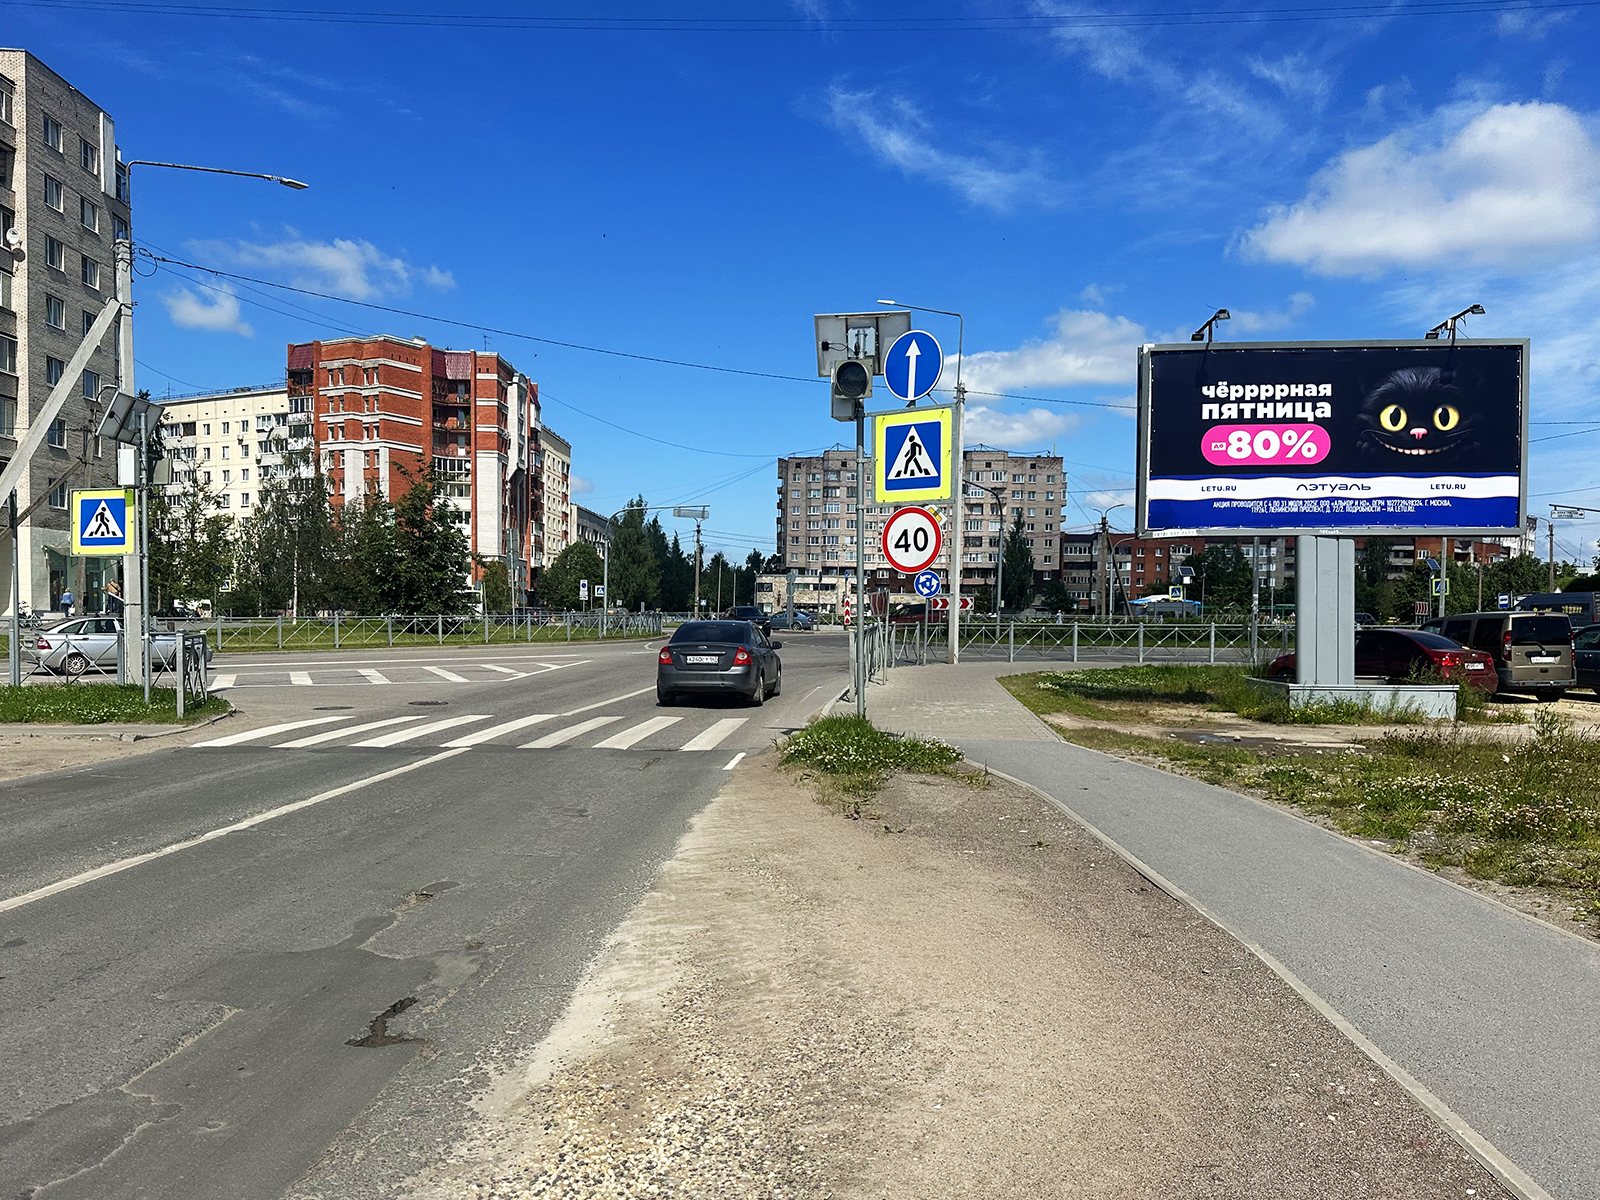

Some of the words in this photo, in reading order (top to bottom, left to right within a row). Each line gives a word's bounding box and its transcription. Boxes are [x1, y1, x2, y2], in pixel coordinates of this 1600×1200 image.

[1201, 381, 1332, 401] чёррррная
[1201, 401, 1332, 422] пятница
[1226, 429, 1318, 459] 80%
[894, 527, 929, 552] 40
